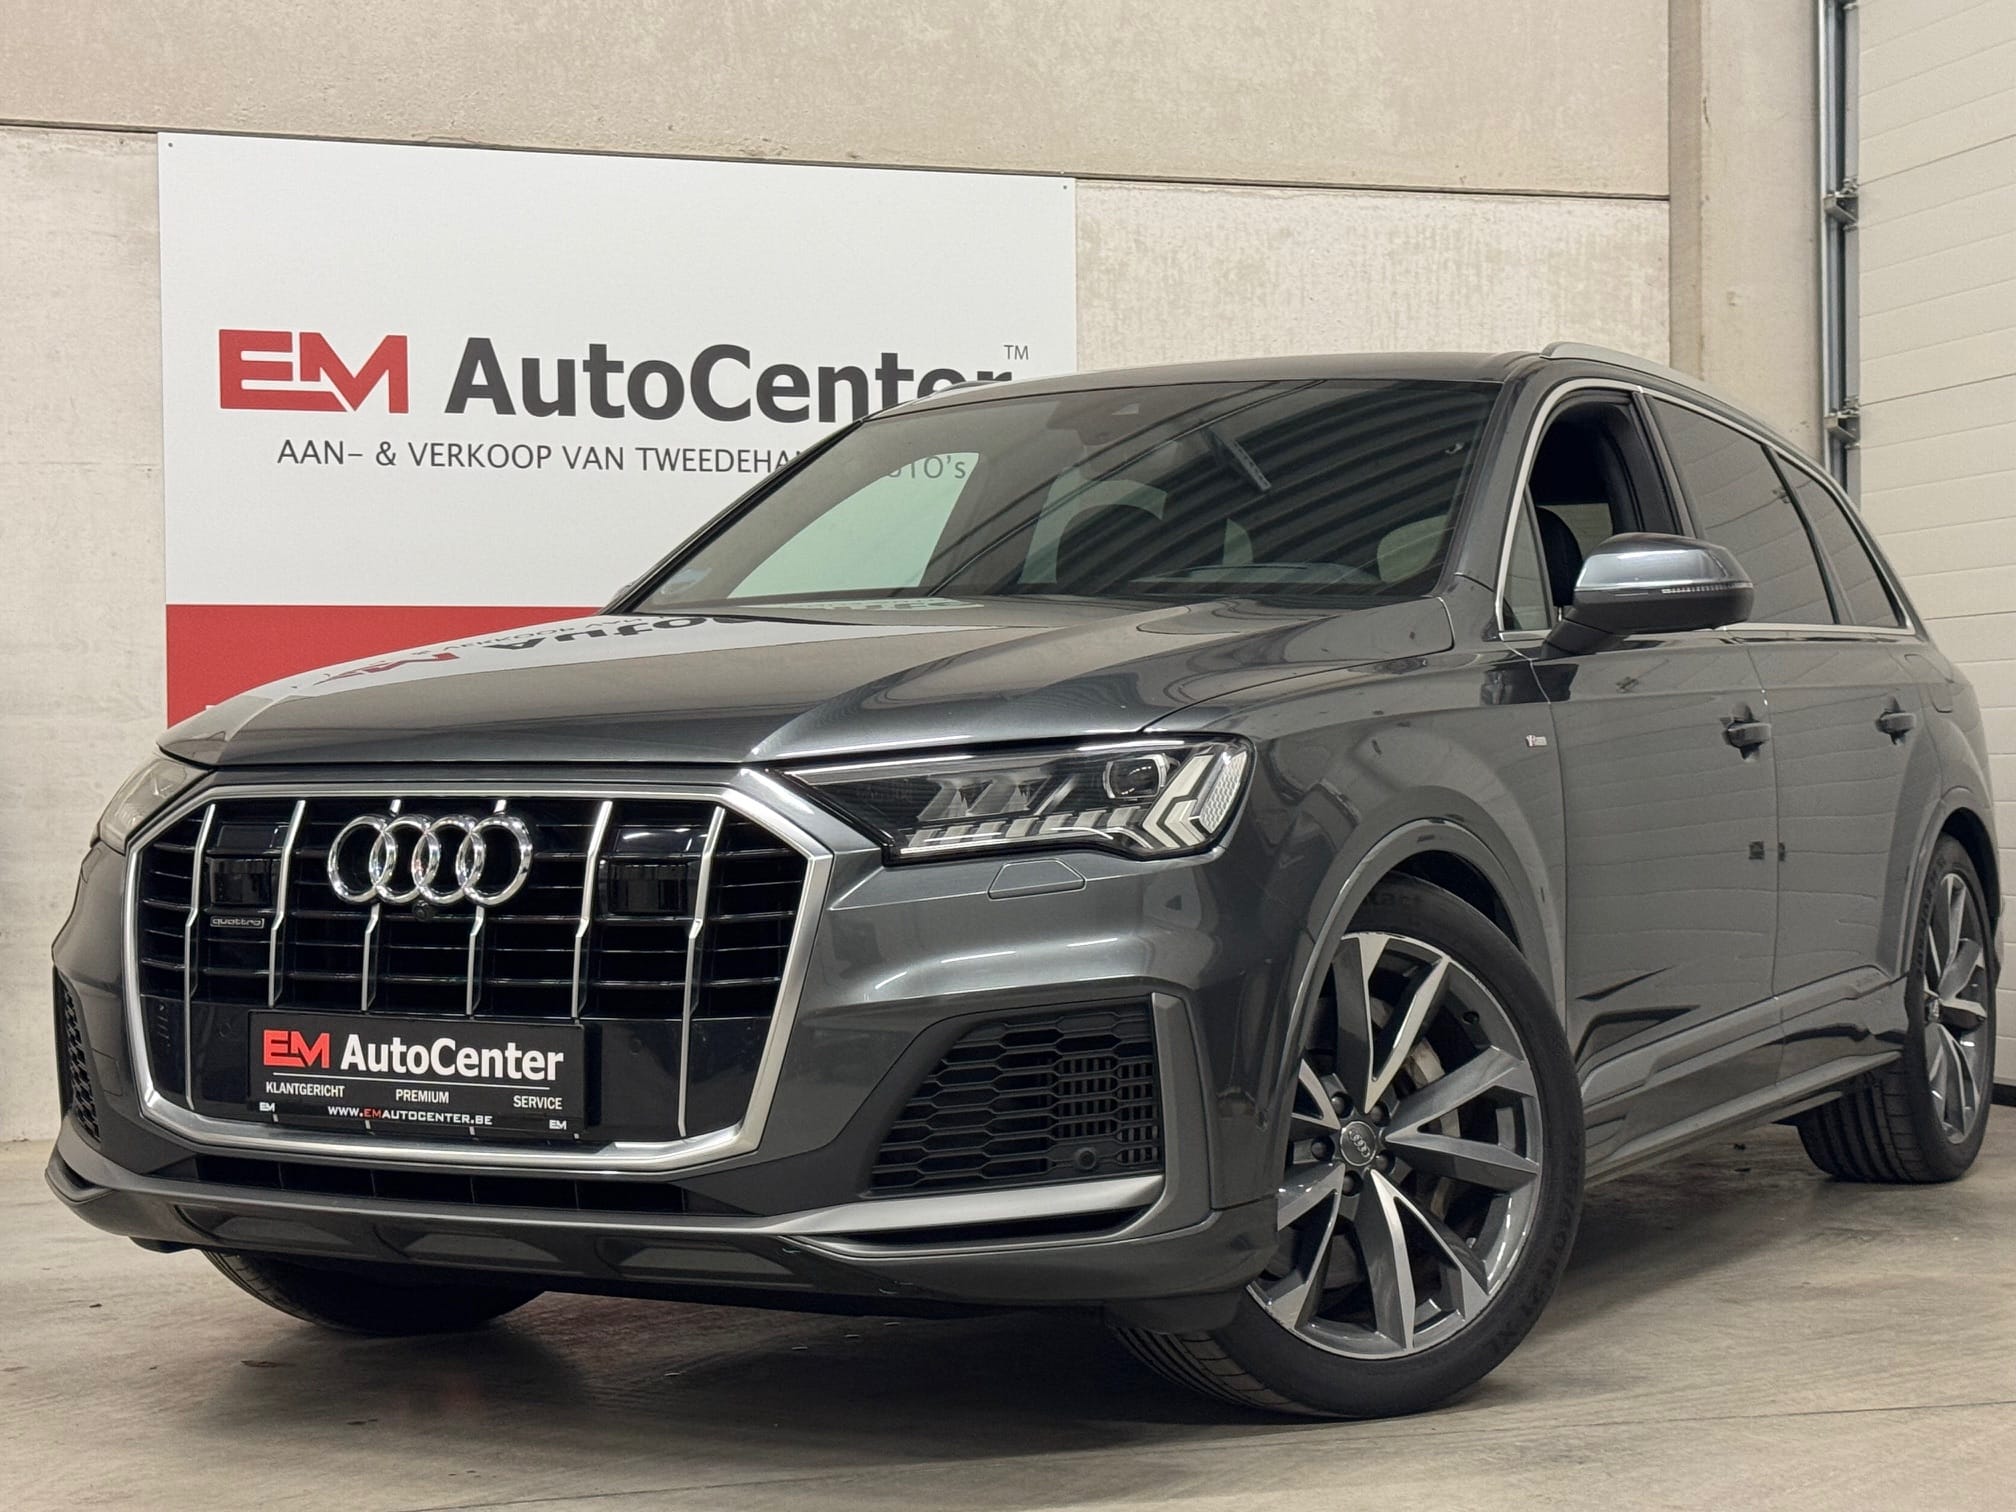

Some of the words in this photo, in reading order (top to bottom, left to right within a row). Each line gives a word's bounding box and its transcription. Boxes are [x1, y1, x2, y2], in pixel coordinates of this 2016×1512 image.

[218, 328, 409, 414] EM
[375, 440, 397, 466] &
[407, 441, 552, 470] VERKOOP
[561, 445, 624, 471] VAN
[212, 918, 262, 927] quattro
[262, 1029, 331, 1069] EM
[340, 1033, 564, 1081] AutoCenter
[265, 1081, 345, 1098] KLANTGERICHT
[395, 1088, 450, 1104] PREMIUM
[513, 1095, 563, 1110] SERVICE
